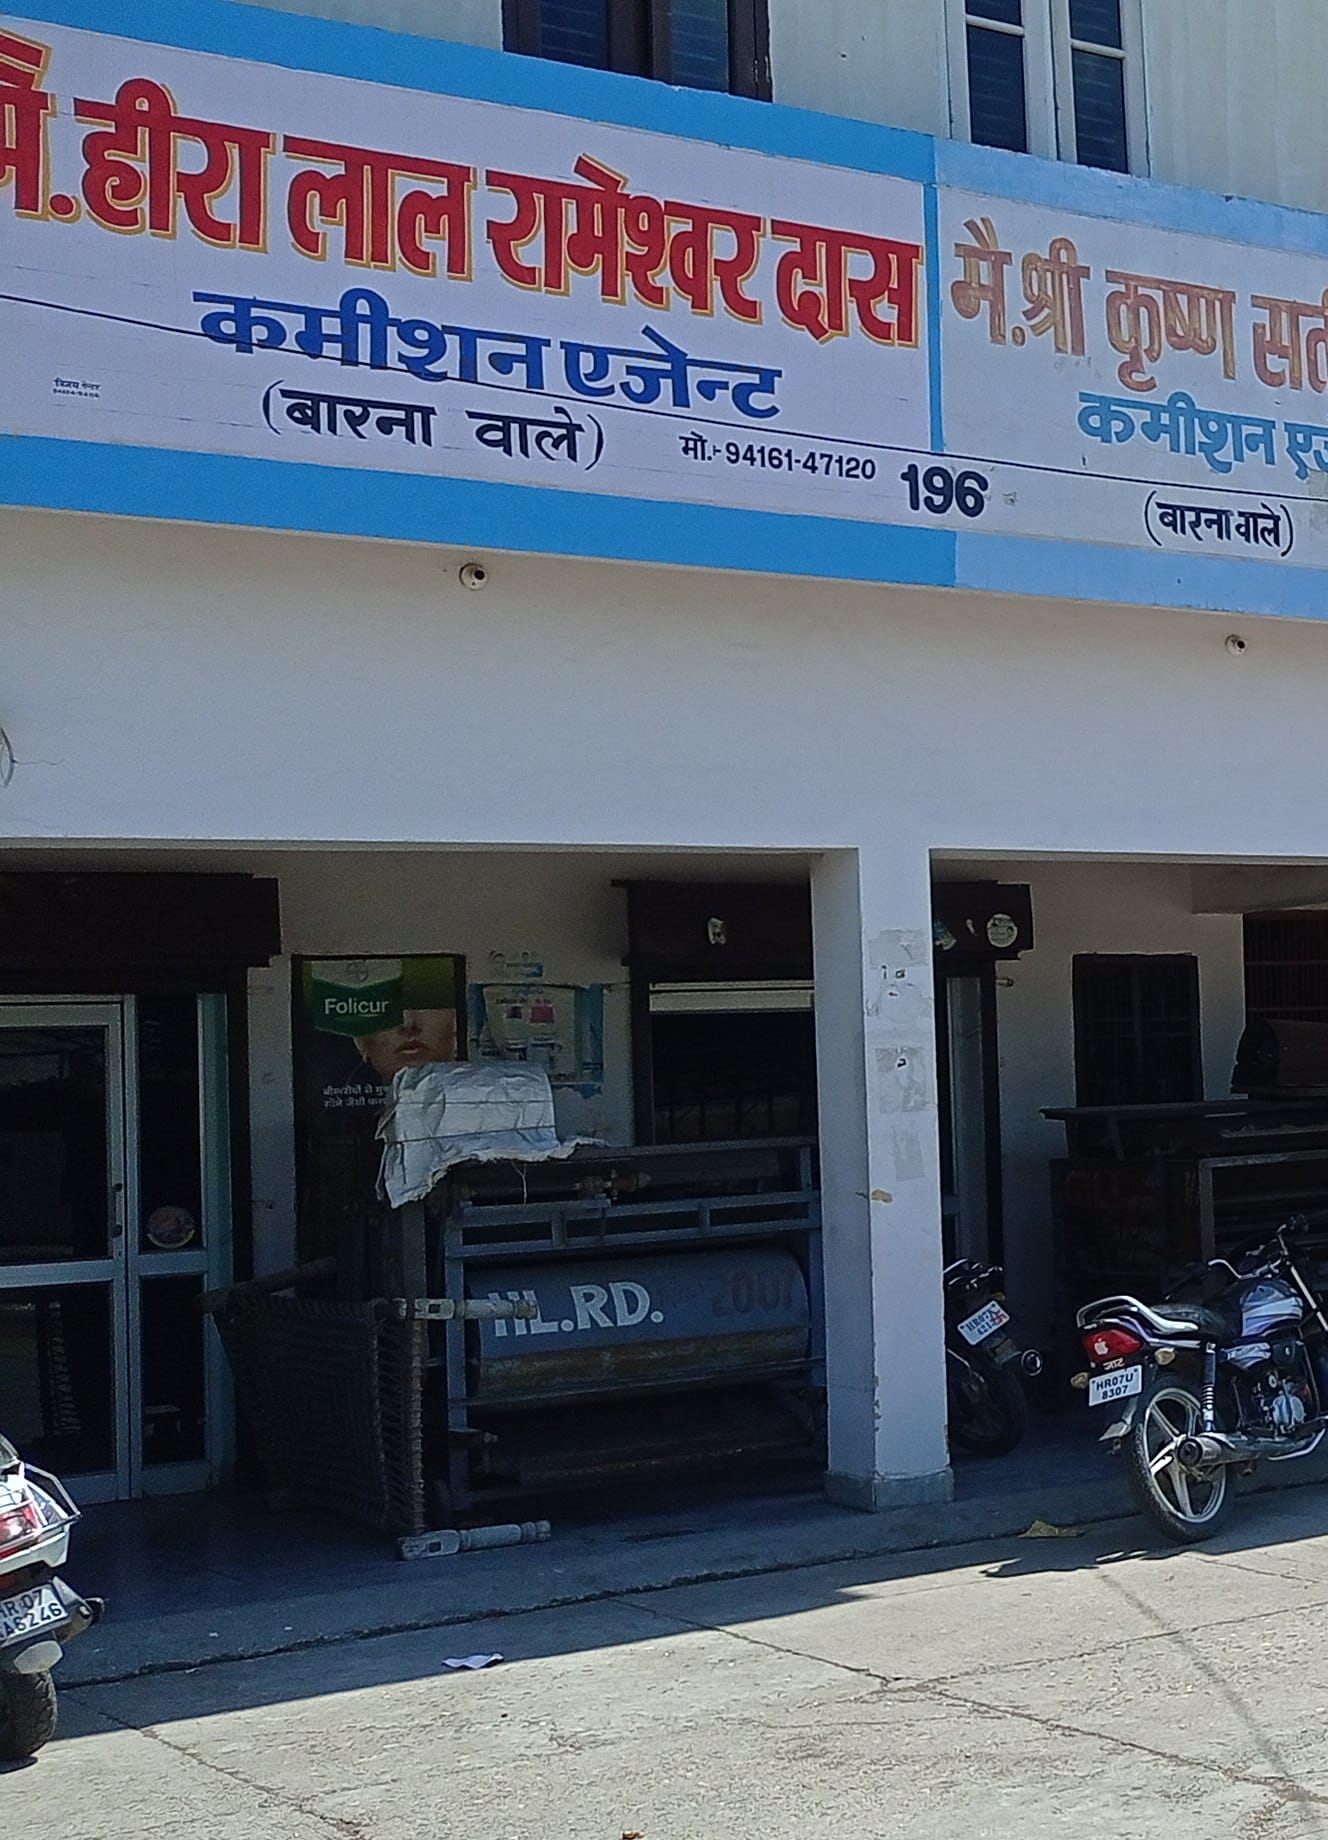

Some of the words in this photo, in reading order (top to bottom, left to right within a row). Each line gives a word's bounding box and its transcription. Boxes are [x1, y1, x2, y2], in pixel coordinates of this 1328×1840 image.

[283, 134, 474, 283] लाल
[484, 153, 766, 325] रामेश्वर
[763, 219, 925, 348] दास
[193, 287, 552, 394] कमीशन
[559, 325, 783, 420] एजेन्ट
[1105, 268, 1237, 393] कृष्ण
[262, 379, 437, 450] (बारना
[466, 403, 606, 472] वाले)
[1077, 390, 1276, 475] कमीशन
[900, 463, 990, 518] 196
[323, 997, 390, 1018] Folicur
[1095, 1372, 1134, 1392] HR07U
[20, 1588, 43, 1610] 07
